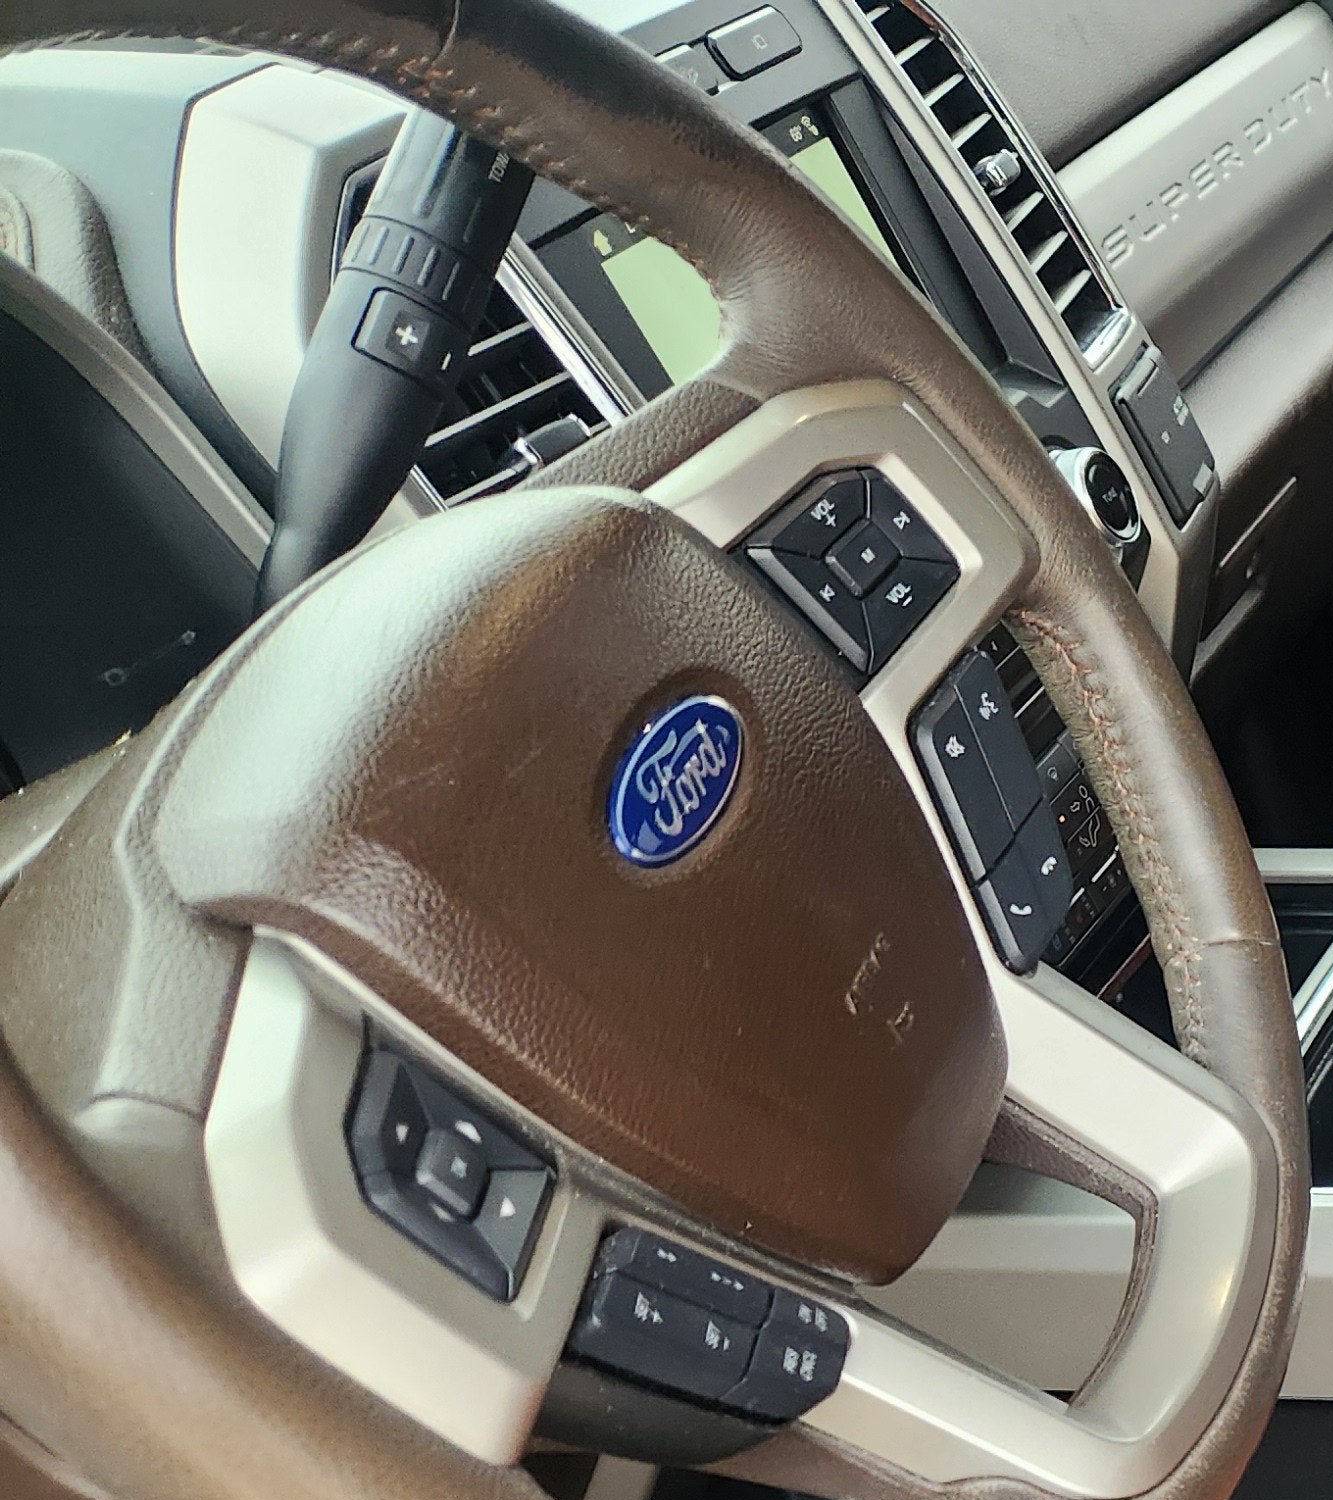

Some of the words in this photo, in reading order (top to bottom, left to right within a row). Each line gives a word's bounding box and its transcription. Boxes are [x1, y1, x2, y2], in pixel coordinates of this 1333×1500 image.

[1101, 142, 1245, 267] SUPER
[811, 498, 835, 521] VOL
[885, 582, 912, 604] VOL
[636, 717, 732, 837] Ford
